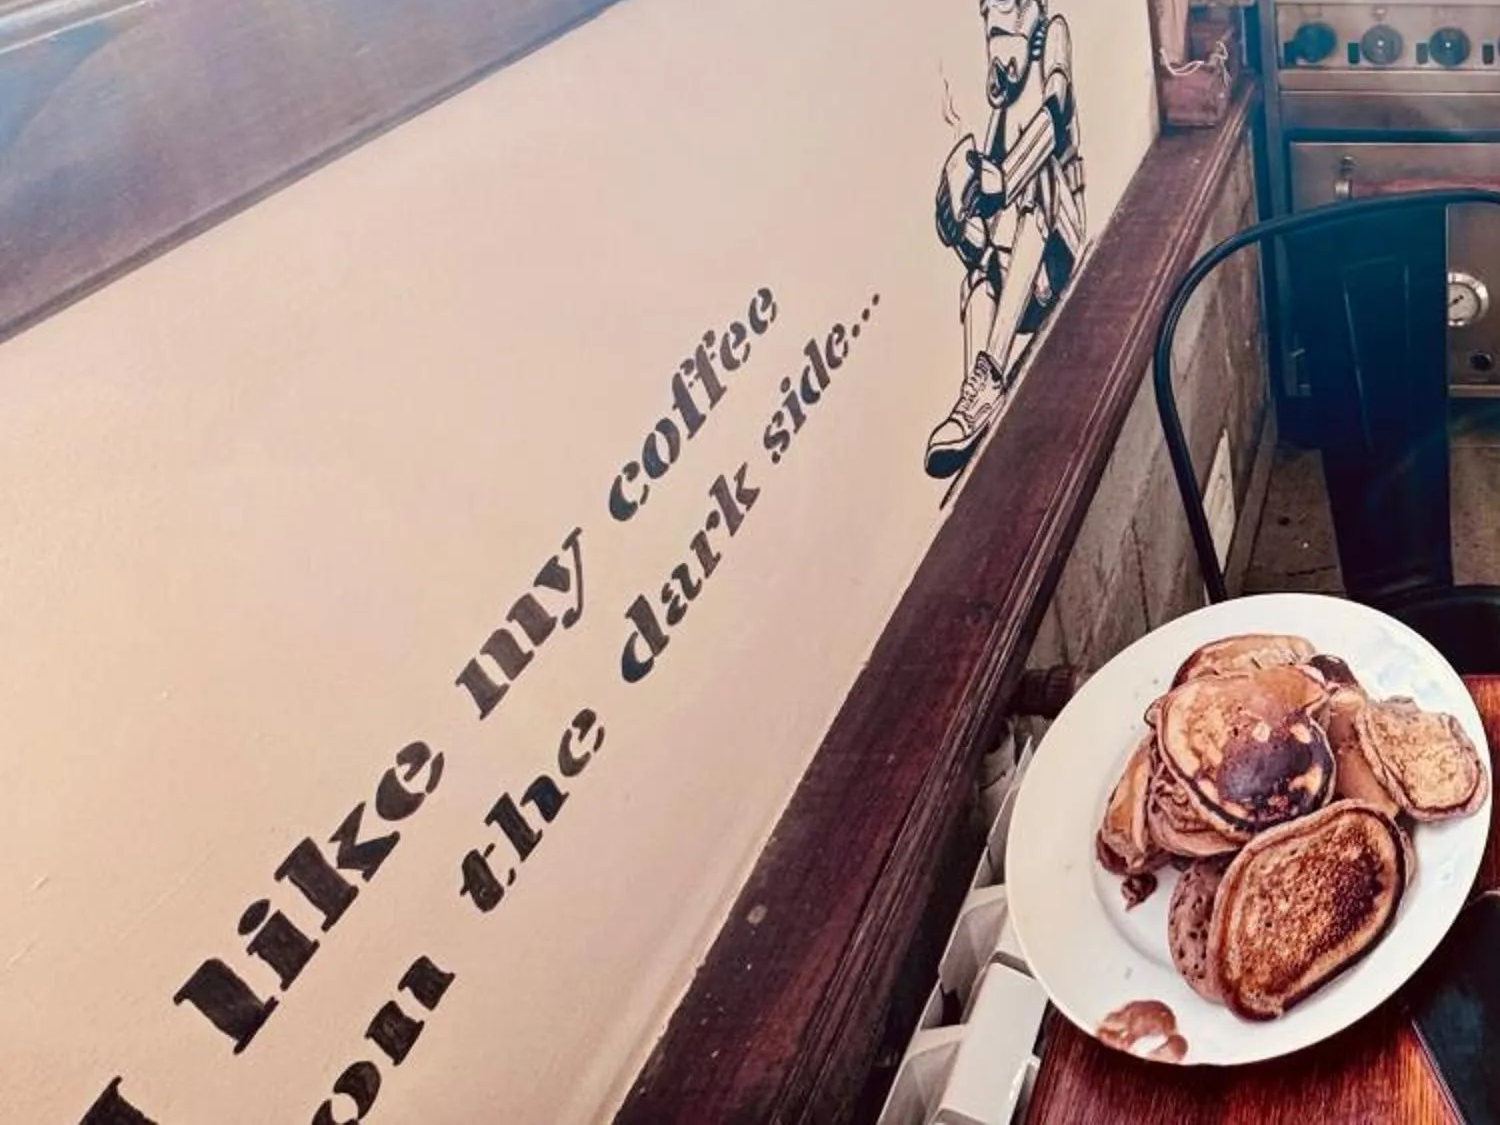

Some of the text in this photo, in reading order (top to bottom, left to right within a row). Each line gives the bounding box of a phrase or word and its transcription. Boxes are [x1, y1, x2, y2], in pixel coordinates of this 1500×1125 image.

[173, 287, 777, 1055] like my coffee
[457, 708, 605, 914] the
[620, 463, 761, 684] dark
